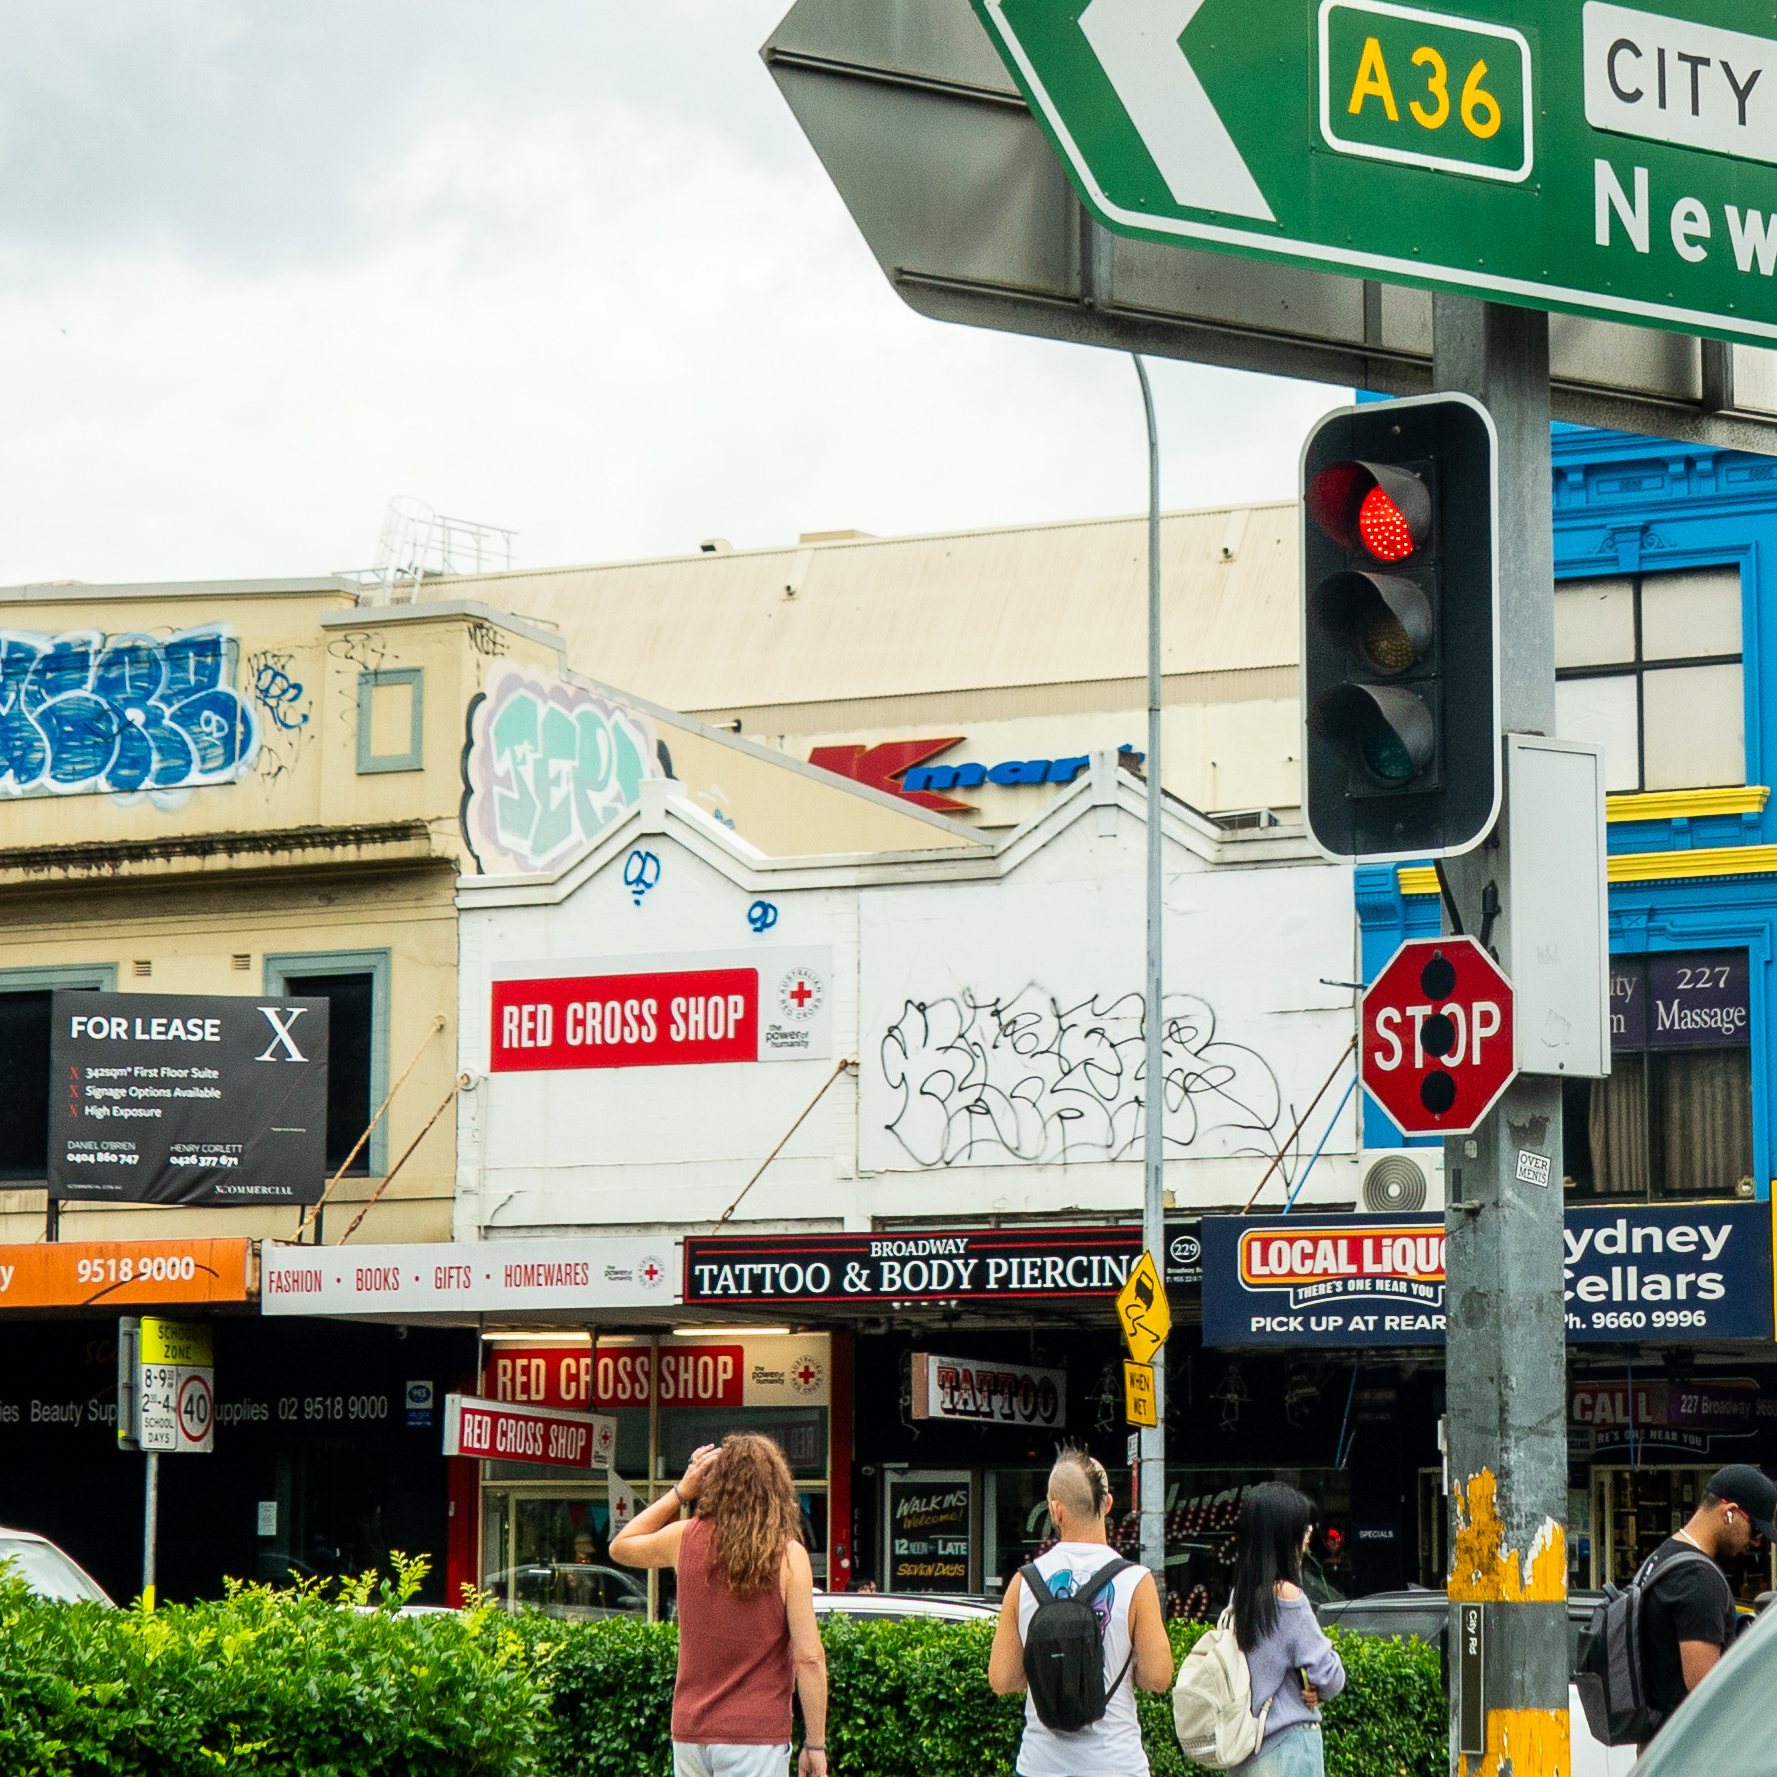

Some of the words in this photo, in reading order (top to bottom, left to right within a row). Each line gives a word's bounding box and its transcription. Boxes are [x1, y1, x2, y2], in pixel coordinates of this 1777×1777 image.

[1348, 36, 1503, 141] A36
[1606, 38, 1763, 126] CITY
[1676, 966, 1731, 990] 227
[501, 1003, 554, 1050] RED
[565, 998, 658, 1045] CROSS
[669, 994, 746, 1042] SHOP
[1655, 998, 1747, 1035] Massage
[71, 1015, 129, 1041] FOR
[135, 1017, 222, 1042] LEASE
[253, 1006, 310, 1063] X
[133, 1067, 159, 1079] First
[160, 1067, 189, 1079] Floor
[191, 1067, 220, 1080] Suite
[85, 1085, 127, 1099] Signage
[128, 1086, 171, 1099] Options
[173, 1086, 222, 1099] Available
[84, 1104, 111, 1119] High
[112, 1105, 162, 1118] Exposure
[1519, 1153, 1549, 1171] OVER
[869, 1237, 970, 1258] BROADWAY
[1173, 1243, 1198, 1256] 229
[1563, 1219, 1734, 1264] ydney
[76, 1257, 133, 1283] 9518
[138, 1255, 196, 1282] 9000
[1250, 1238, 1357, 1276] LOCAL
[267, 1269, 323, 1294] FASHION
[355, 1267, 400, 1293] BOOKS
[433, 1265, 472, 1290] GIFTS
[503, 1262, 590, 1288] HOMEWARES
[694, 1262, 831, 1296] TATTOO
[842, 1261, 869, 1292] &
[879, 1258, 979, 1292] BODY
[1296, 1279, 1343, 1299] THERE'S
[1347, 1279, 1372, 1292] ONE
[1375, 1279, 1407, 1293] NEAR
[1411, 1282, 1434, 1299] YOU
[1250, 1317, 1304, 1332] PICK
[1310, 1316, 1343, 1331] UP
[1347, 1315, 1379, 1331] AT
[1384, 1314, 1446, 1330] REAR
[1591, 1312, 1647, 1329] 9660
[1652, 1309, 1707, 1328] 9996
[158, 1324, 199, 1342] SCHOOL
[164, 1343, 192, 1360] ZONE
[496, 1357, 547, 1402] RED
[558, 1356, 650, 1401] CROSS
[659, 1354, 735, 1400] SHOP
[1129, 1372, 1151, 1392] WHEN
[936, 1365, 1058, 1424] TATTOO
[1679, 1393, 1699, 1414] 227
[1701, 1395, 1752, 1419] Broadway
[29, 1399, 83, 1428] Beauty
[278, 1398, 299, 1420] 02
[303, 1397, 343, 1420] 9518
[347, 1396, 389, 1419] 9000
[183, 1392, 209, 1424] 40
[1133, 1397, 1148, 1417] WET
[147, 1431, 171, 1444] DAYS
[462, 1412, 492, 1450] RED
[495, 1417, 544, 1456] CROSS
[547, 1423, 587, 1461] SHOP
[1648, 1427, 1679, 1442] NEAR
[895, 1495, 942, 1519] WALK
[894, 1538, 909, 1555] 12
[896, 1562, 935, 1577] SEVEN
[1466, 1609, 1478, 1634] City
[1468, 1637, 1478, 1655] Rd
